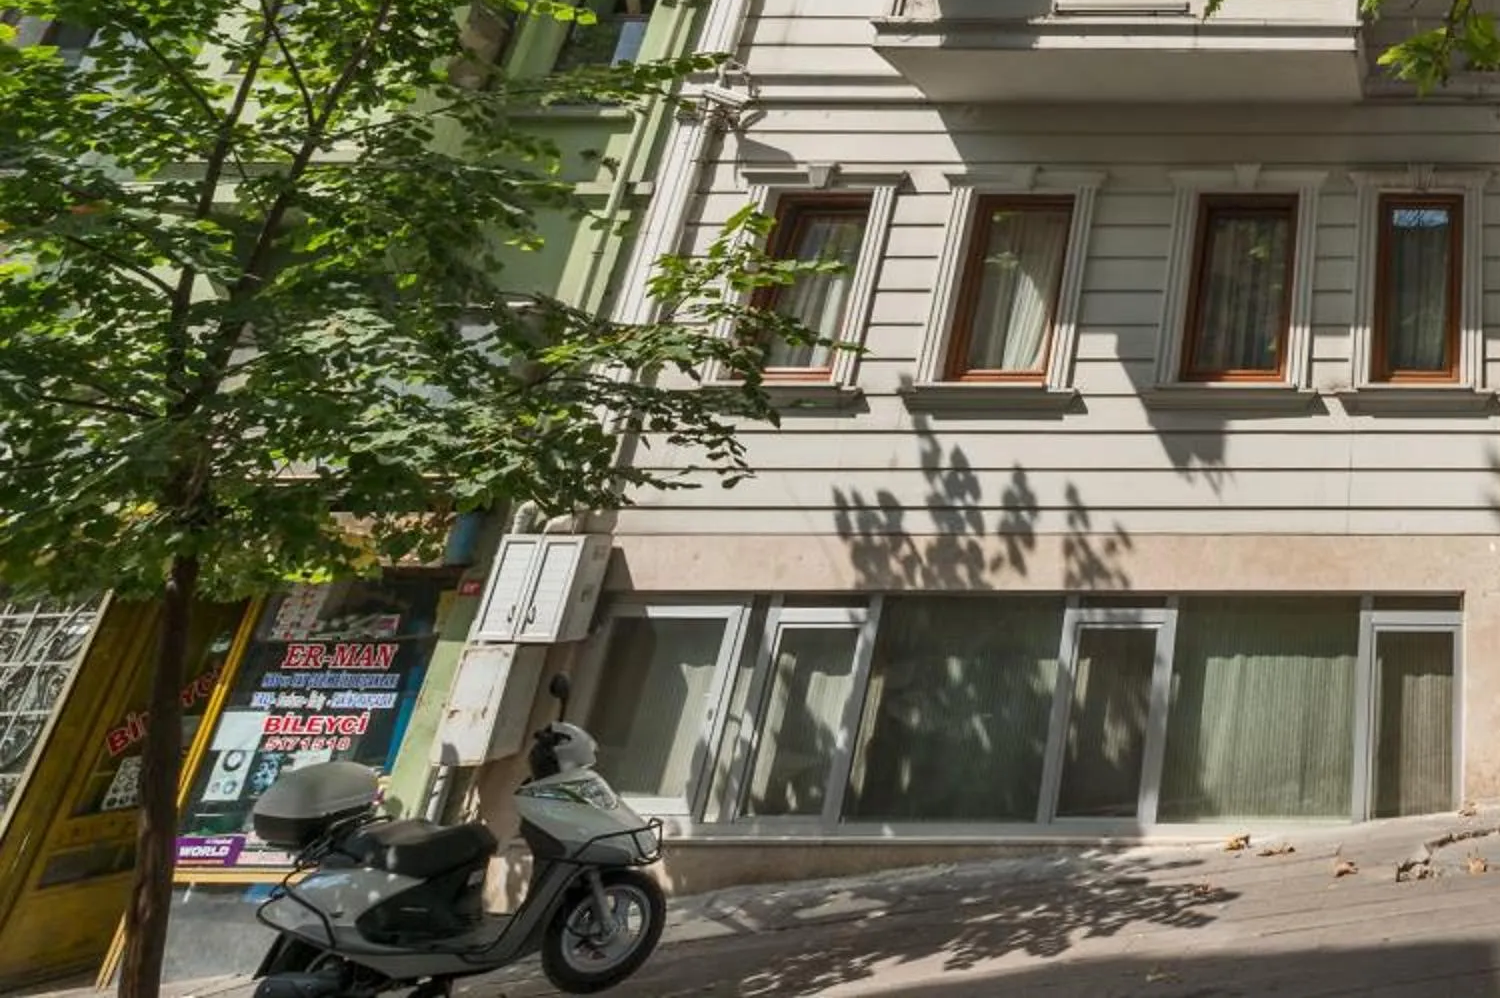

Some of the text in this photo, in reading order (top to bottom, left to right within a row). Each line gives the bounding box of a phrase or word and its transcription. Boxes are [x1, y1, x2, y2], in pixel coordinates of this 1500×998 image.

[280, 643, 400, 669] ER-MAN
[261, 711, 371, 735] BİLEYCİ
[180, 845, 230, 857] WORLD
